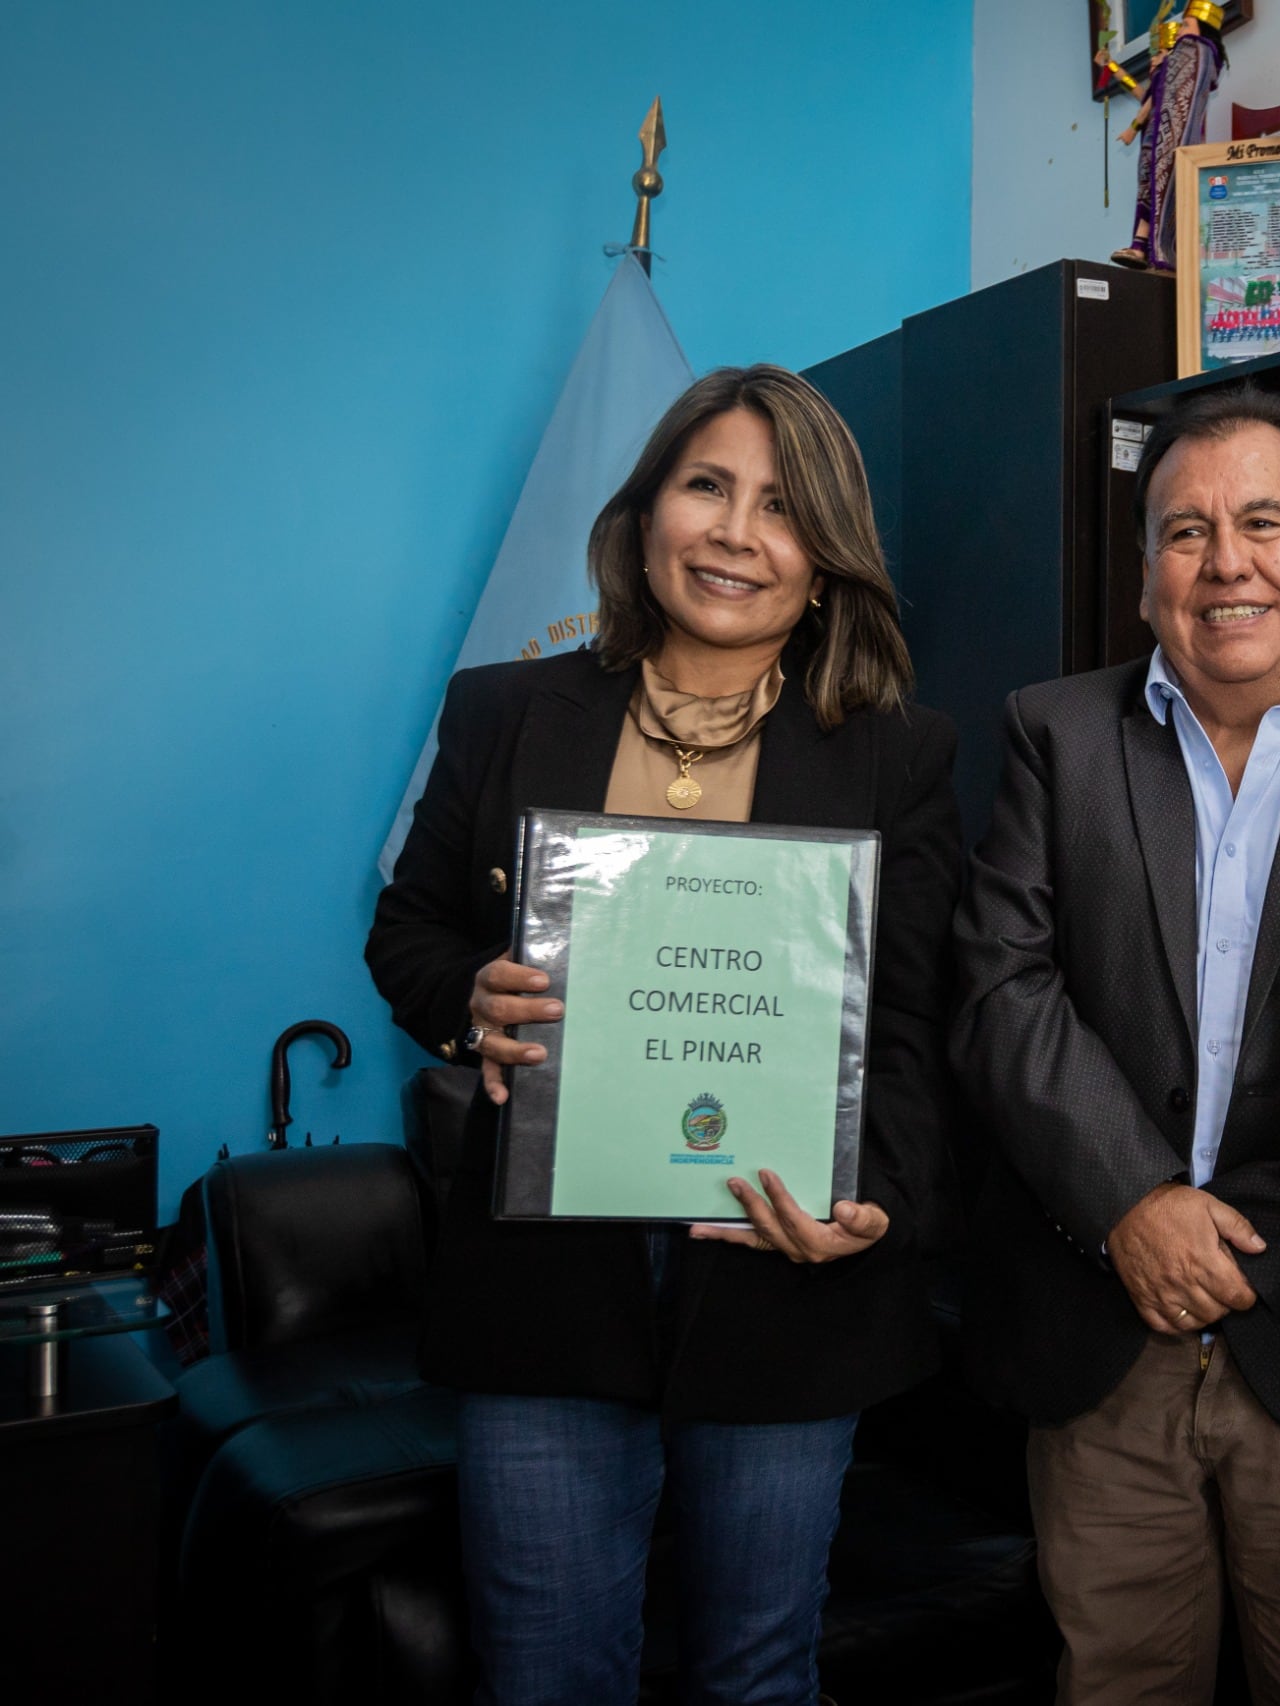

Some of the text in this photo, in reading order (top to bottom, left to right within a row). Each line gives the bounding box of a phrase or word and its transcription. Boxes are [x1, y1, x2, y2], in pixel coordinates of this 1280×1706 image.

[1227, 144, 1245, 160] Mi
[514, 637, 541, 661] AD
[665, 876, 763, 896] PROYECTO:
[656, 946, 763, 972] CENTRO
[629, 989, 785, 1017] COMERCIAL
[645, 1039, 762, 1064] EL PINAR
